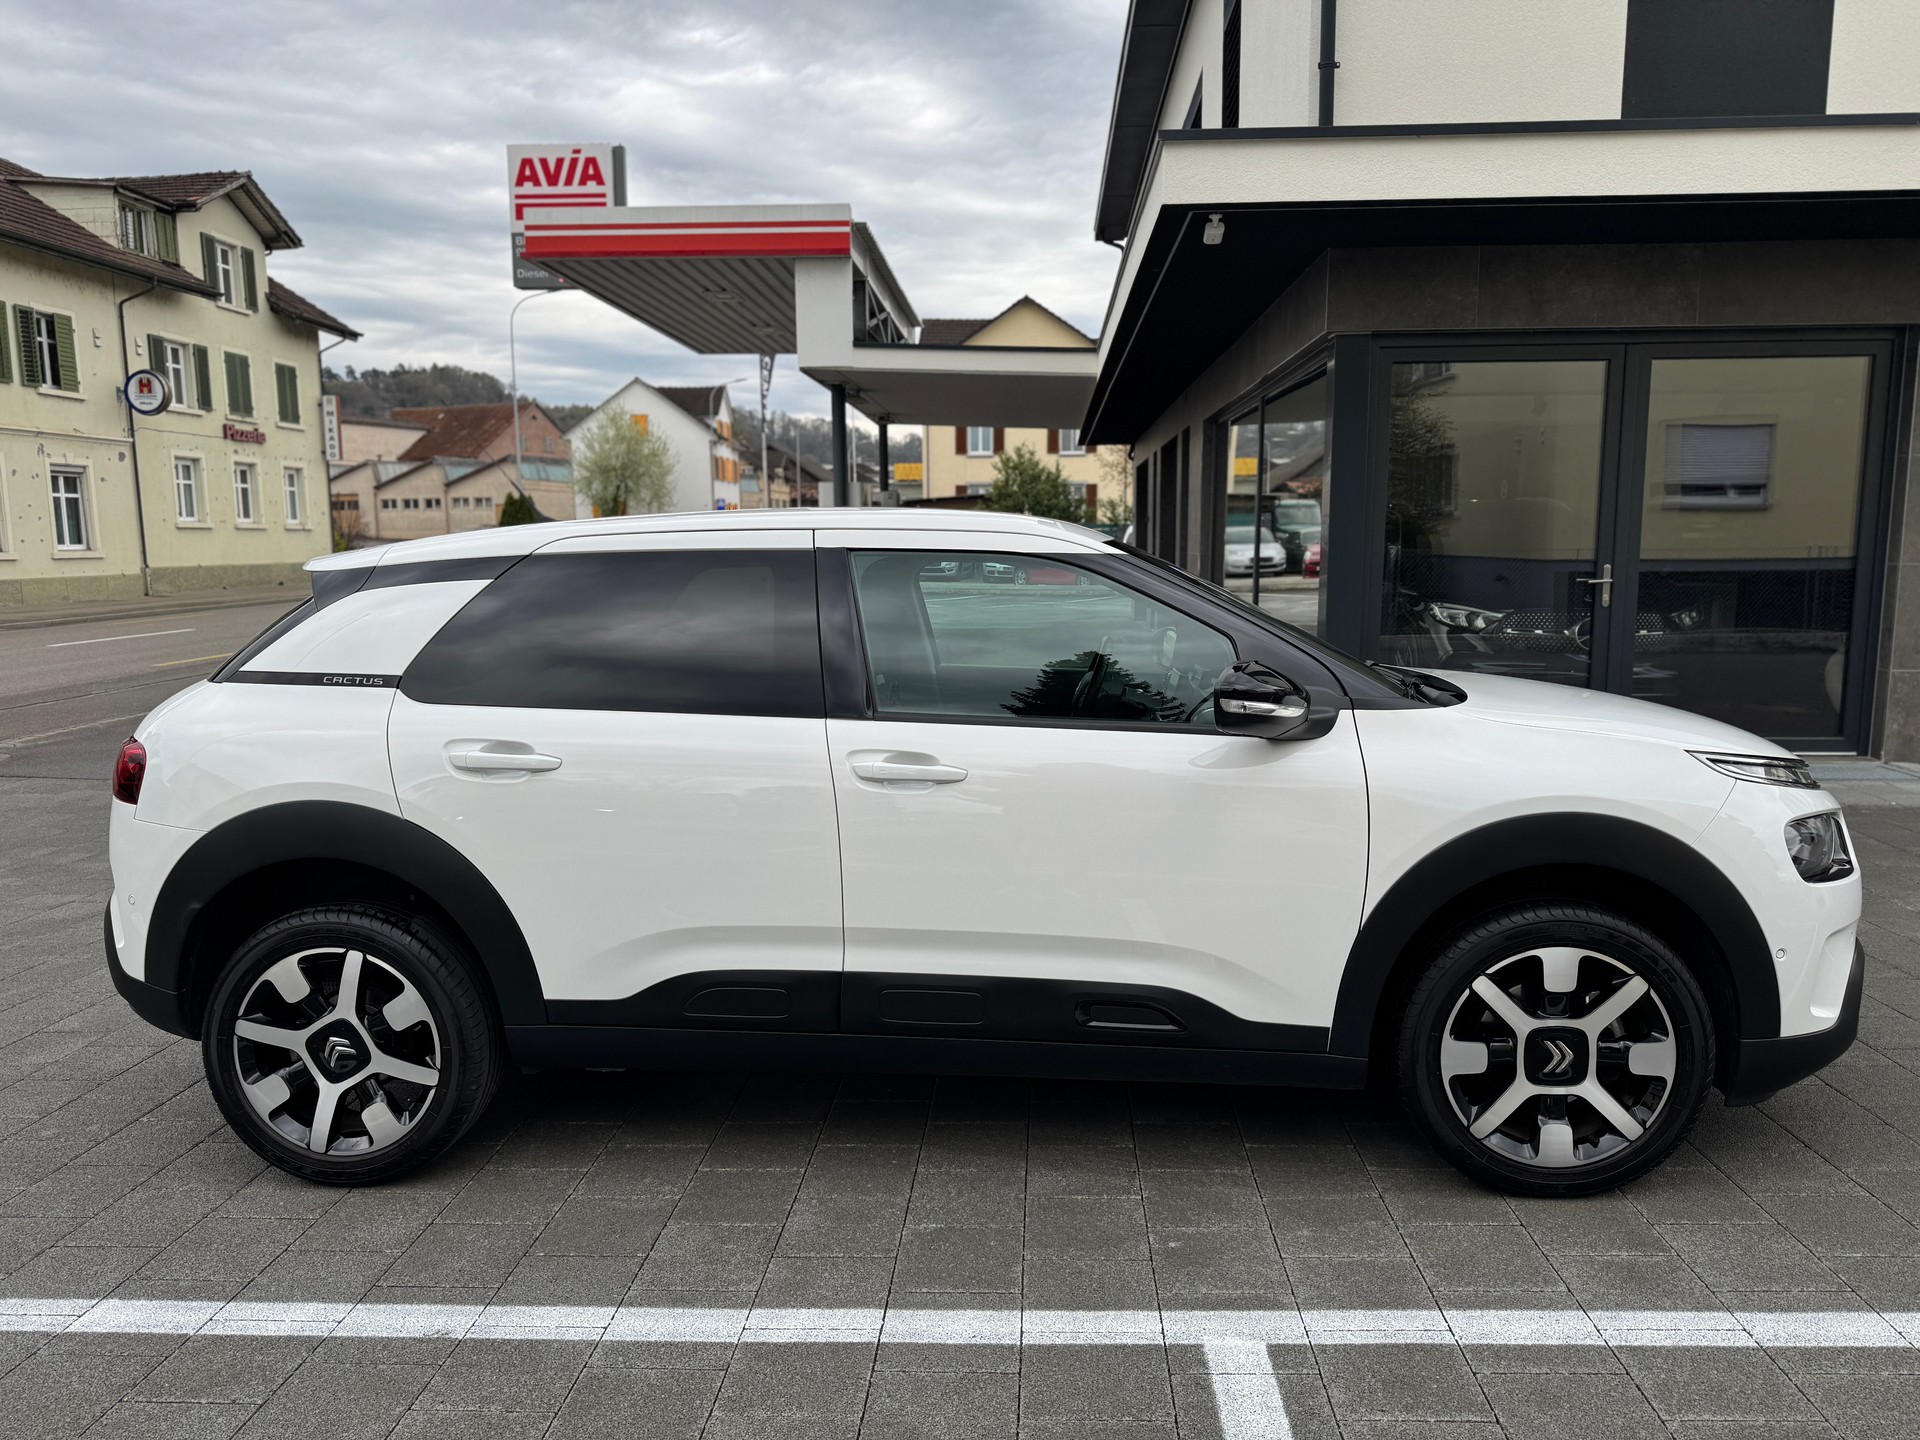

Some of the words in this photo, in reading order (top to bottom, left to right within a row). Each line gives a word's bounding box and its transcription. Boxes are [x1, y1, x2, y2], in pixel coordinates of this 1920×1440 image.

[223, 423, 267, 446] Pizzeria
[326, 410, 337, 459] MIKADO
[323, 676, 383, 685] CACTUS
